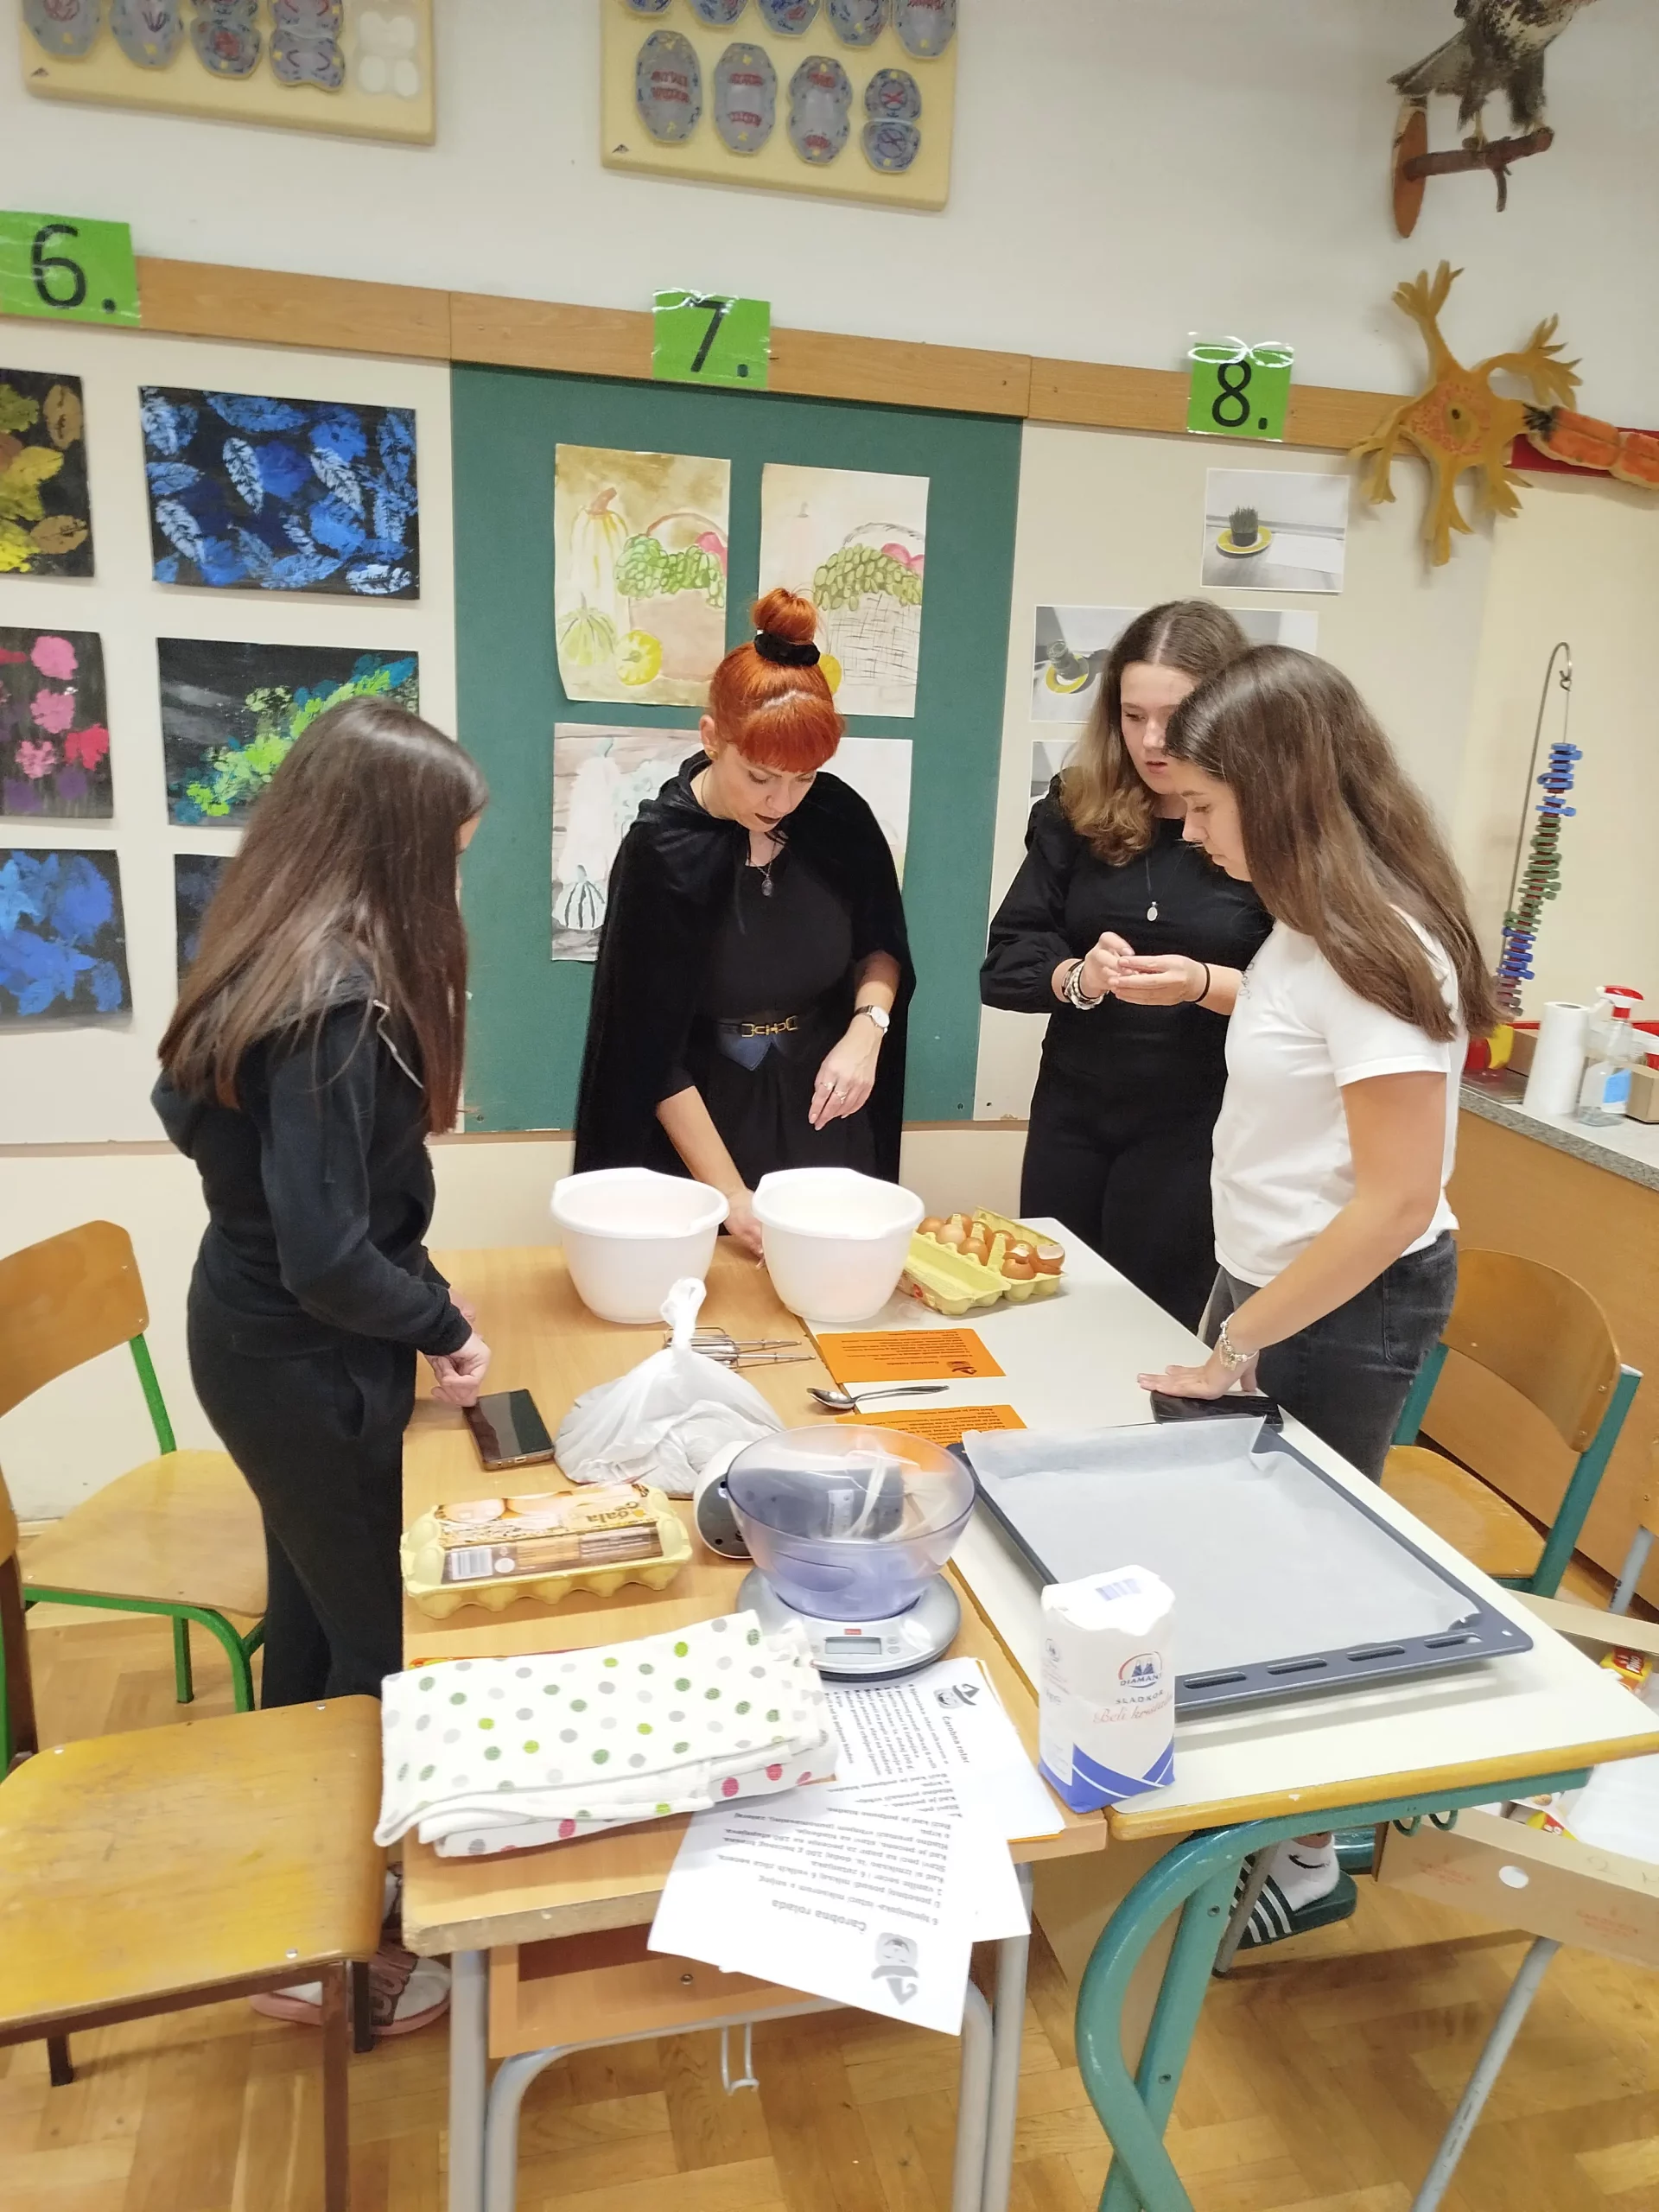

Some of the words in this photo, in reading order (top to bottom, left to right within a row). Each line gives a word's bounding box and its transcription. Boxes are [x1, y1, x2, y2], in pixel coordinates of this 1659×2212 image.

[31, 224, 117, 313] 6.
[684, 297, 748, 378] 7.
[1211, 357, 1268, 430] 8.
[772, 1899, 811, 1915] rolada
